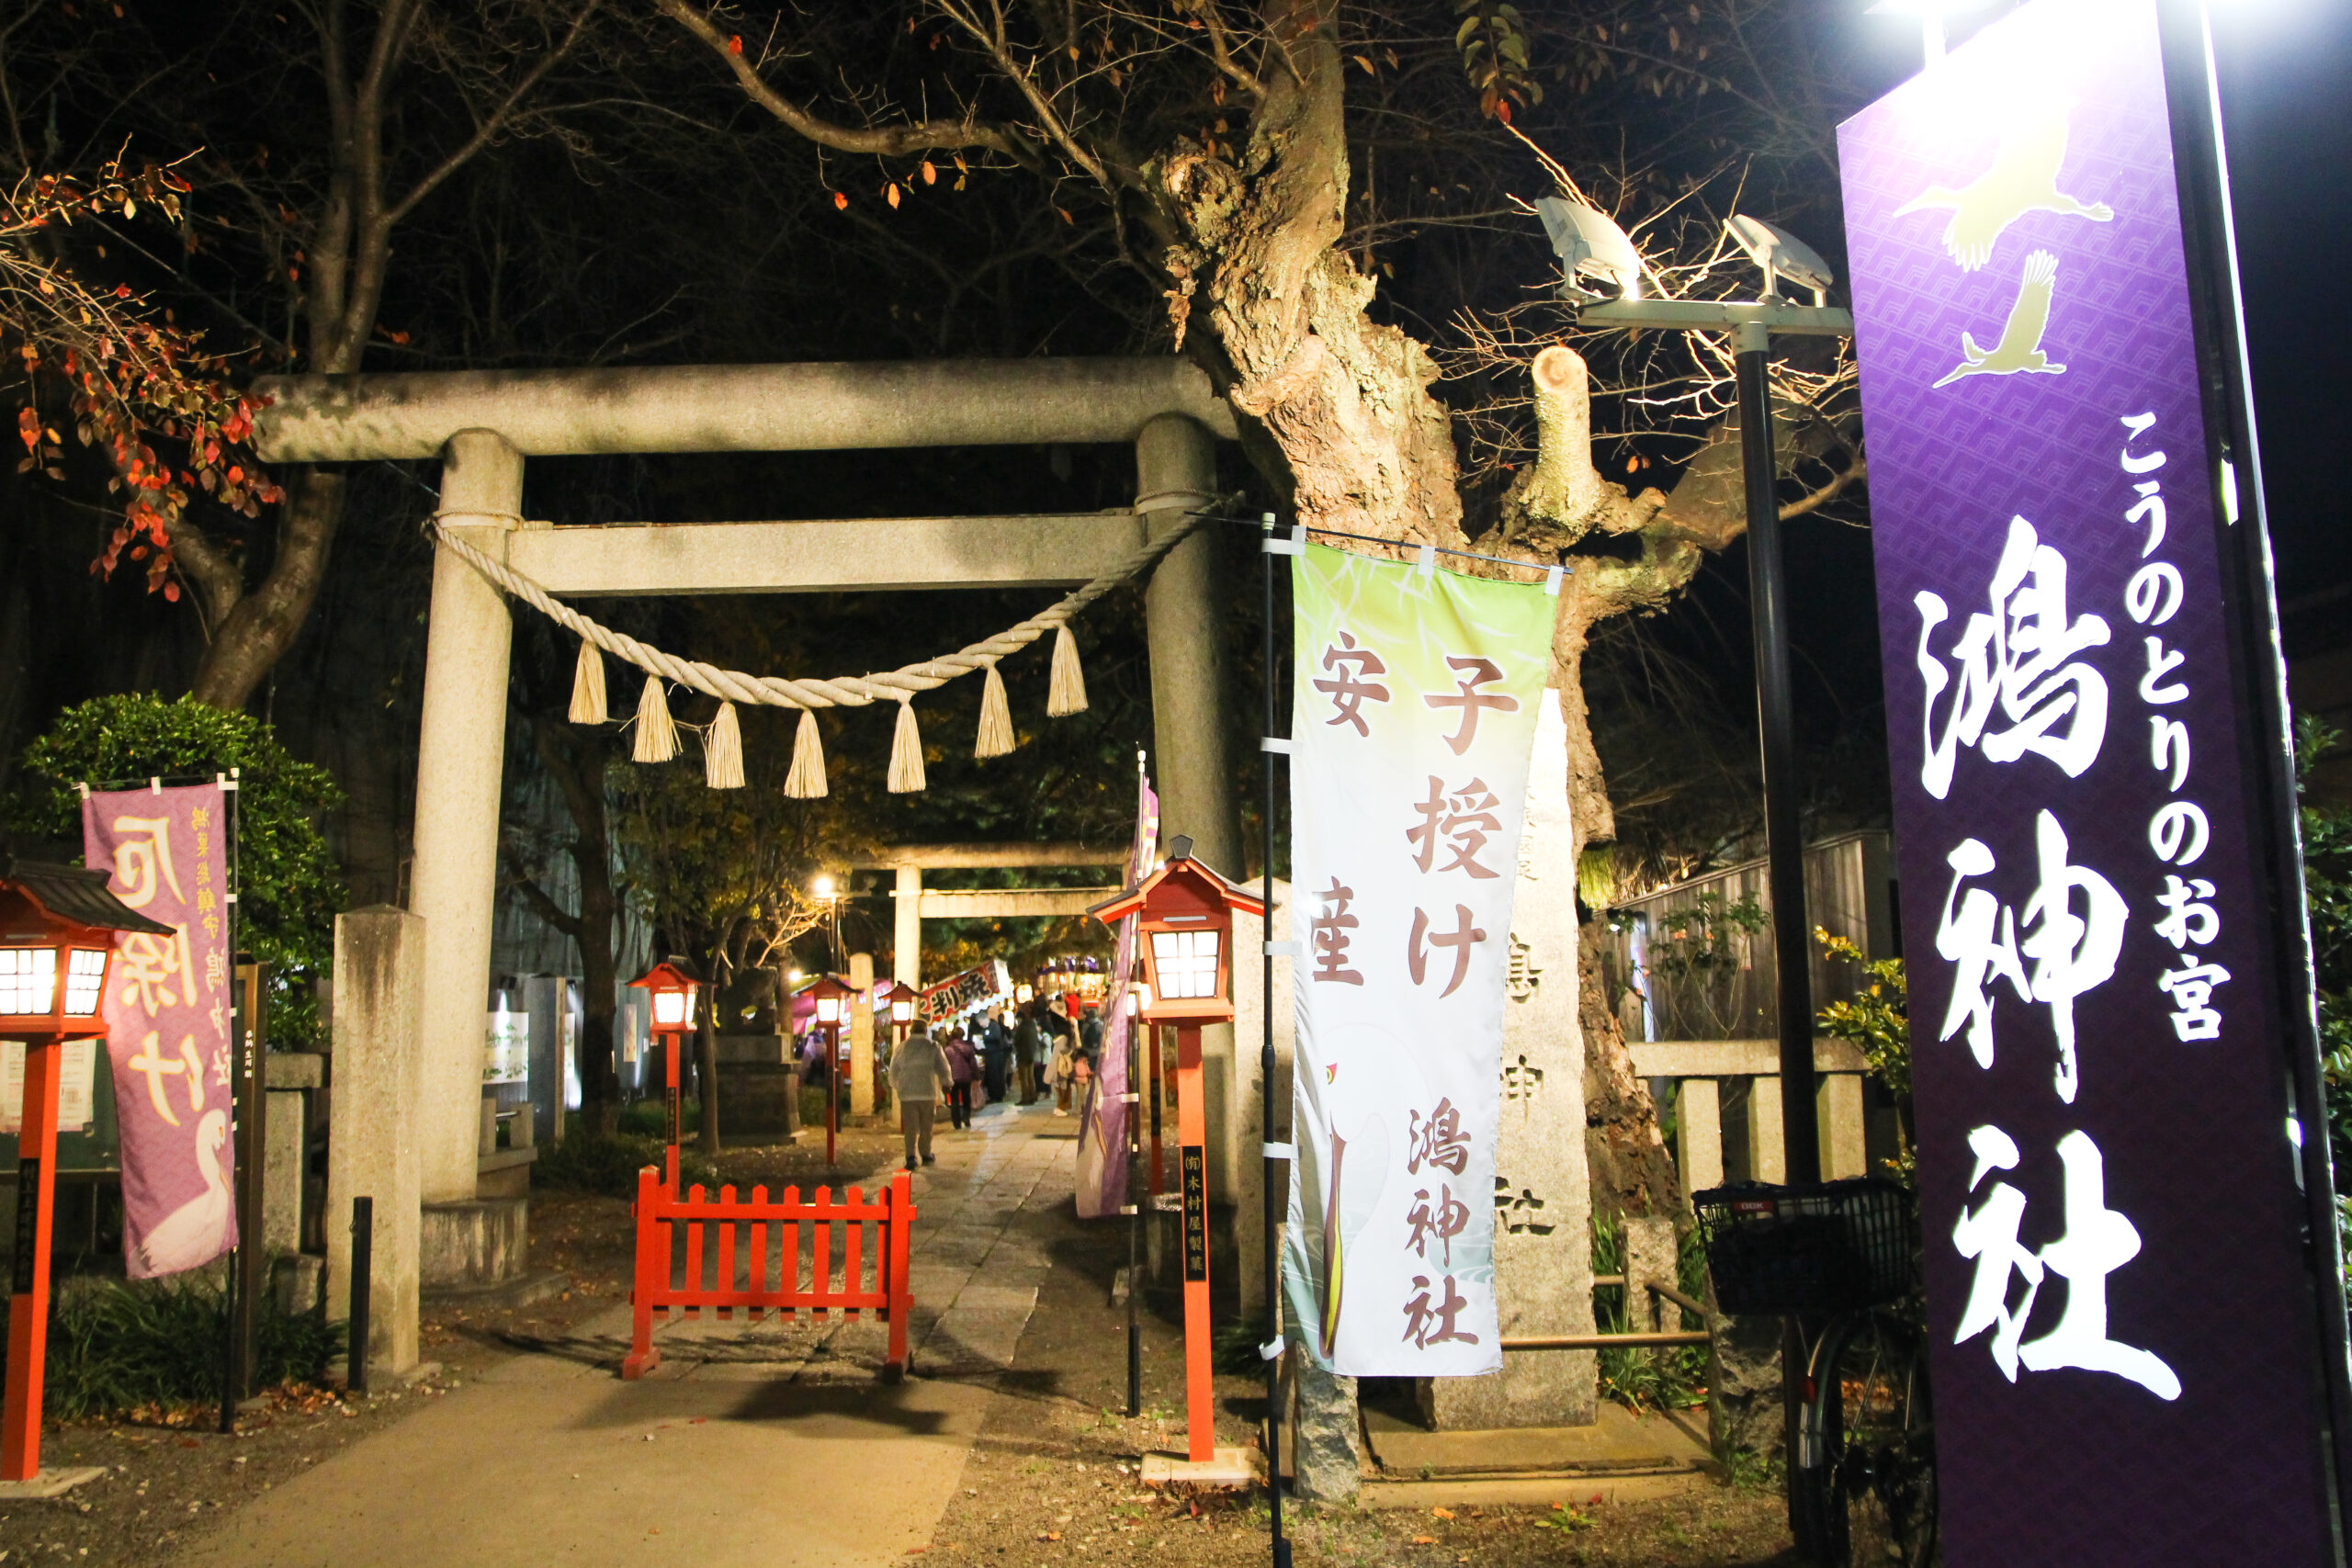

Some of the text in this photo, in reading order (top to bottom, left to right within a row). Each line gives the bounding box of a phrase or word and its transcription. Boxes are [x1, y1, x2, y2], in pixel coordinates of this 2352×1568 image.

[1310, 629, 1390, 988] 安産
[1407, 653, 1521, 999] 子授け
[2119, 412, 2233, 1043] こうのとりのお宮
[1913, 513, 2181, 1402] 鴻神社
[1401, 1096, 1480, 1350] 鴻神社
